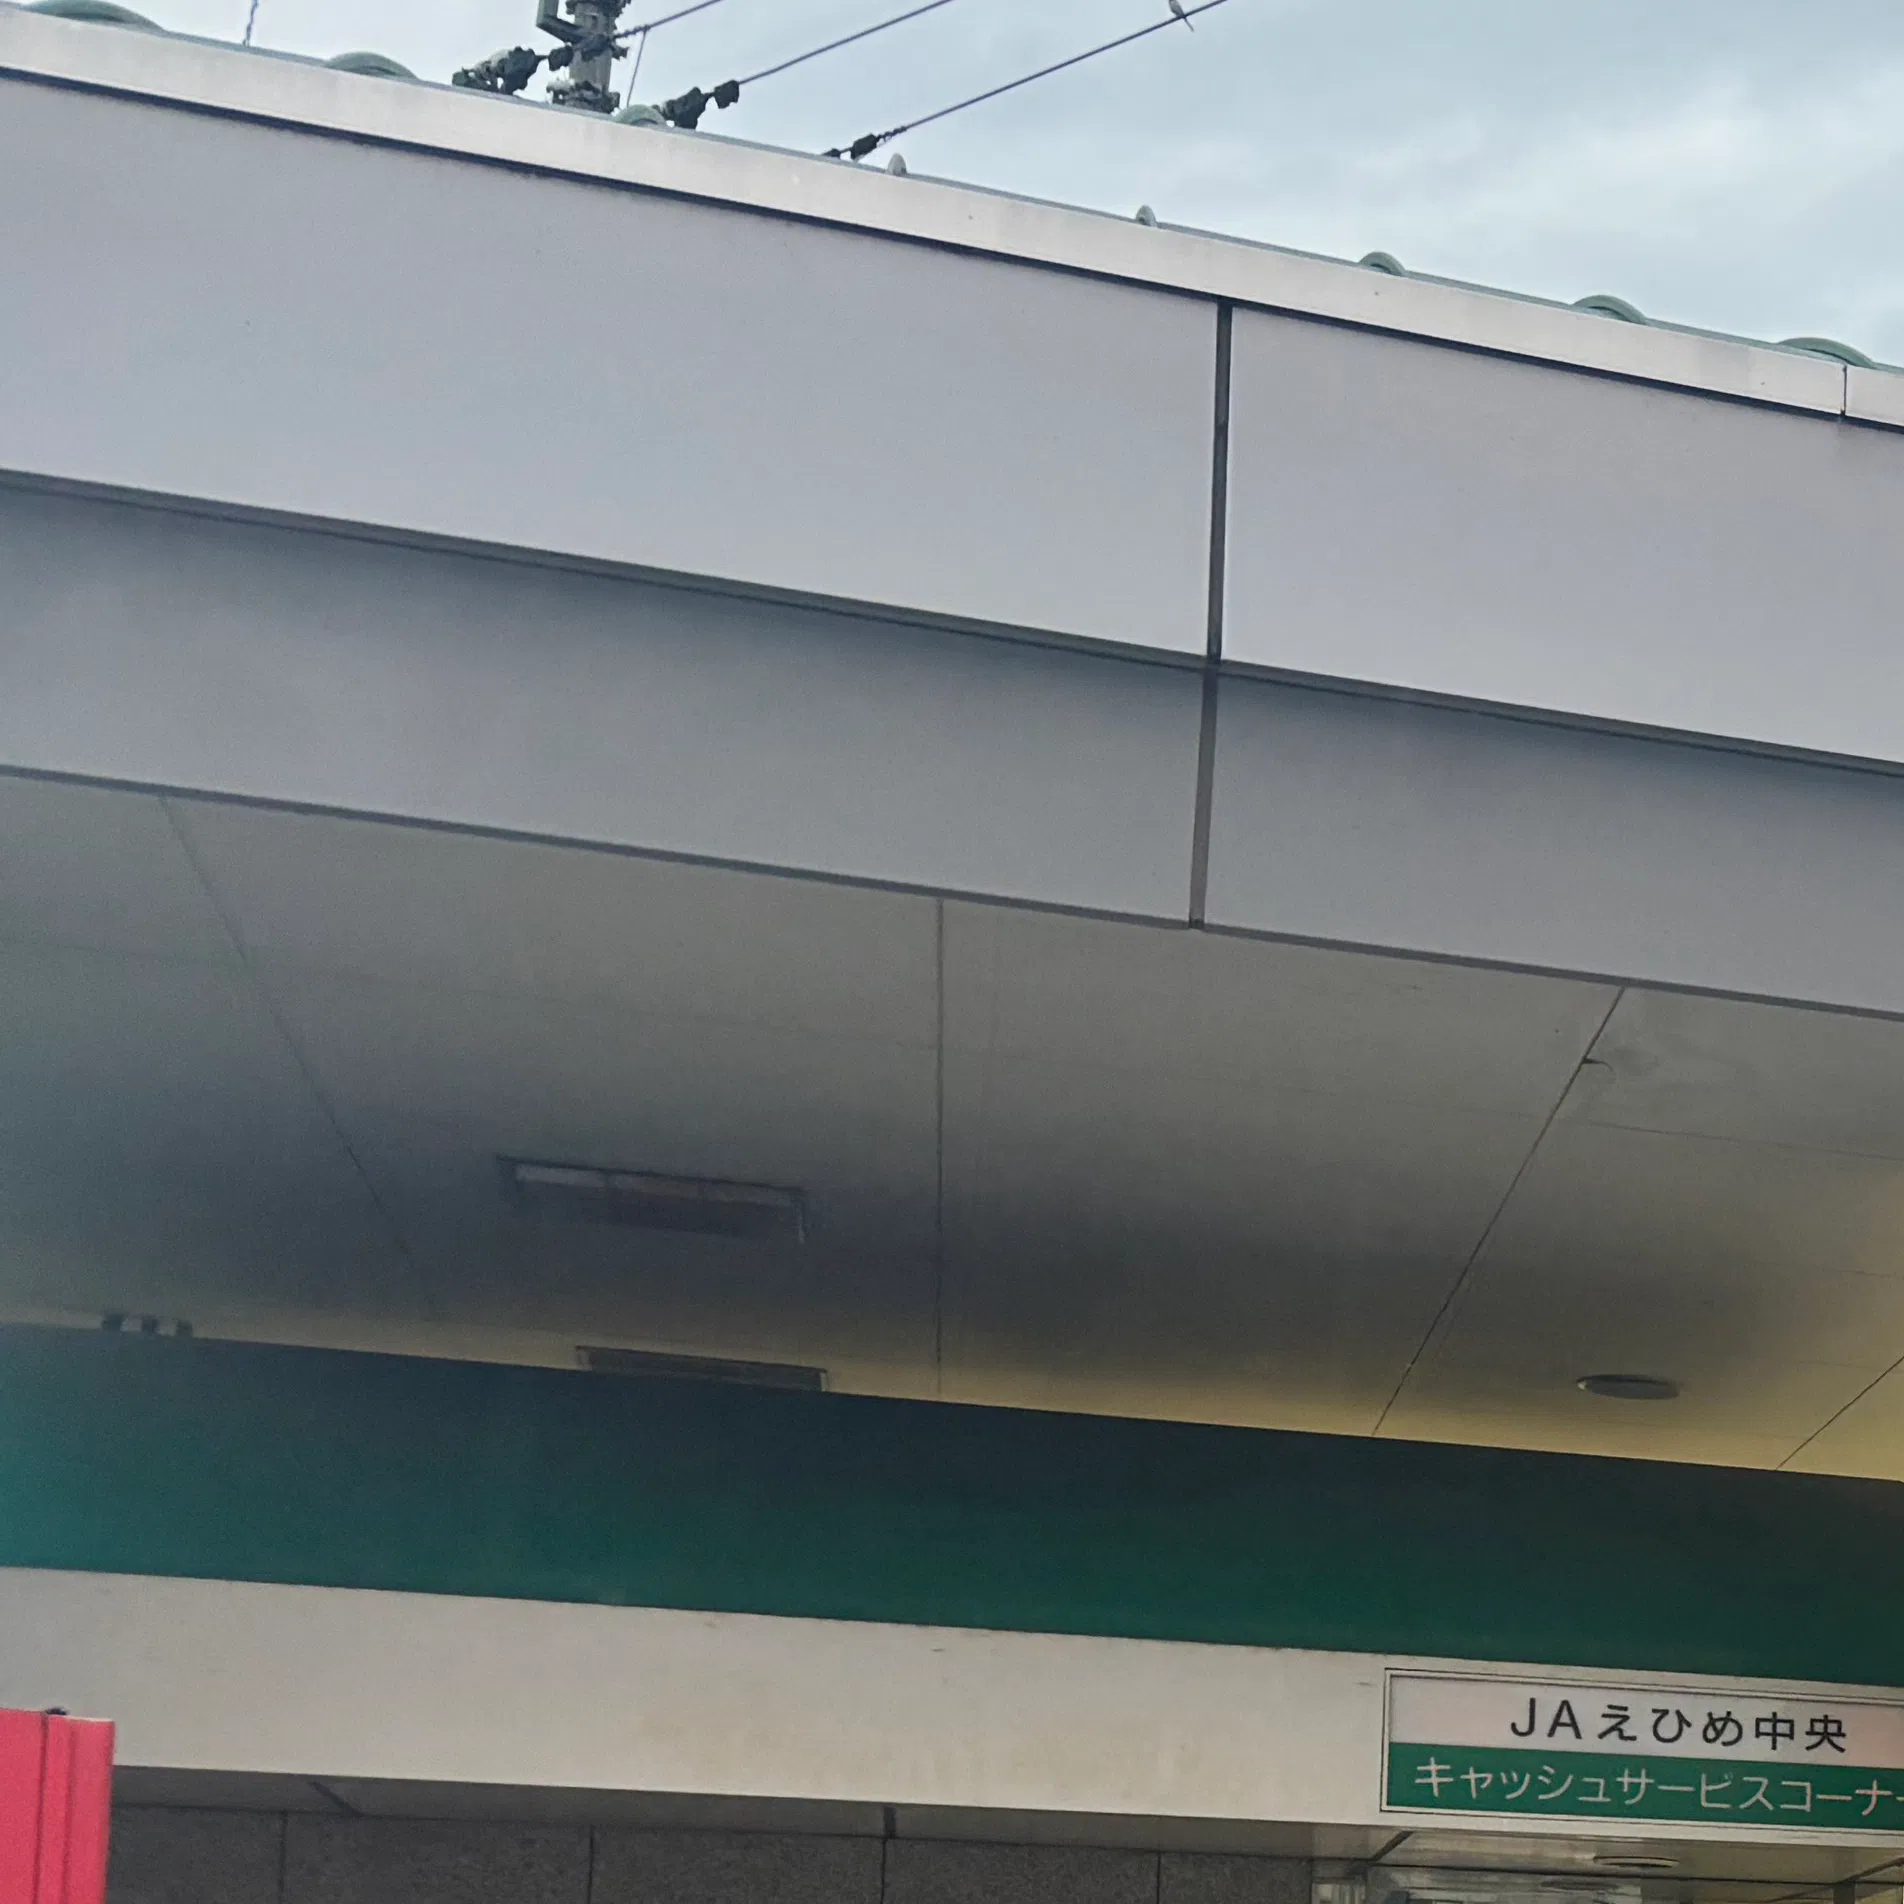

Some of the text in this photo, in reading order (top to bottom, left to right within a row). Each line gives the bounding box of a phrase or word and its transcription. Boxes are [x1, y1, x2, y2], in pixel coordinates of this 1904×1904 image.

[1510, 1697, 1848, 1753] JAえひめ中央
